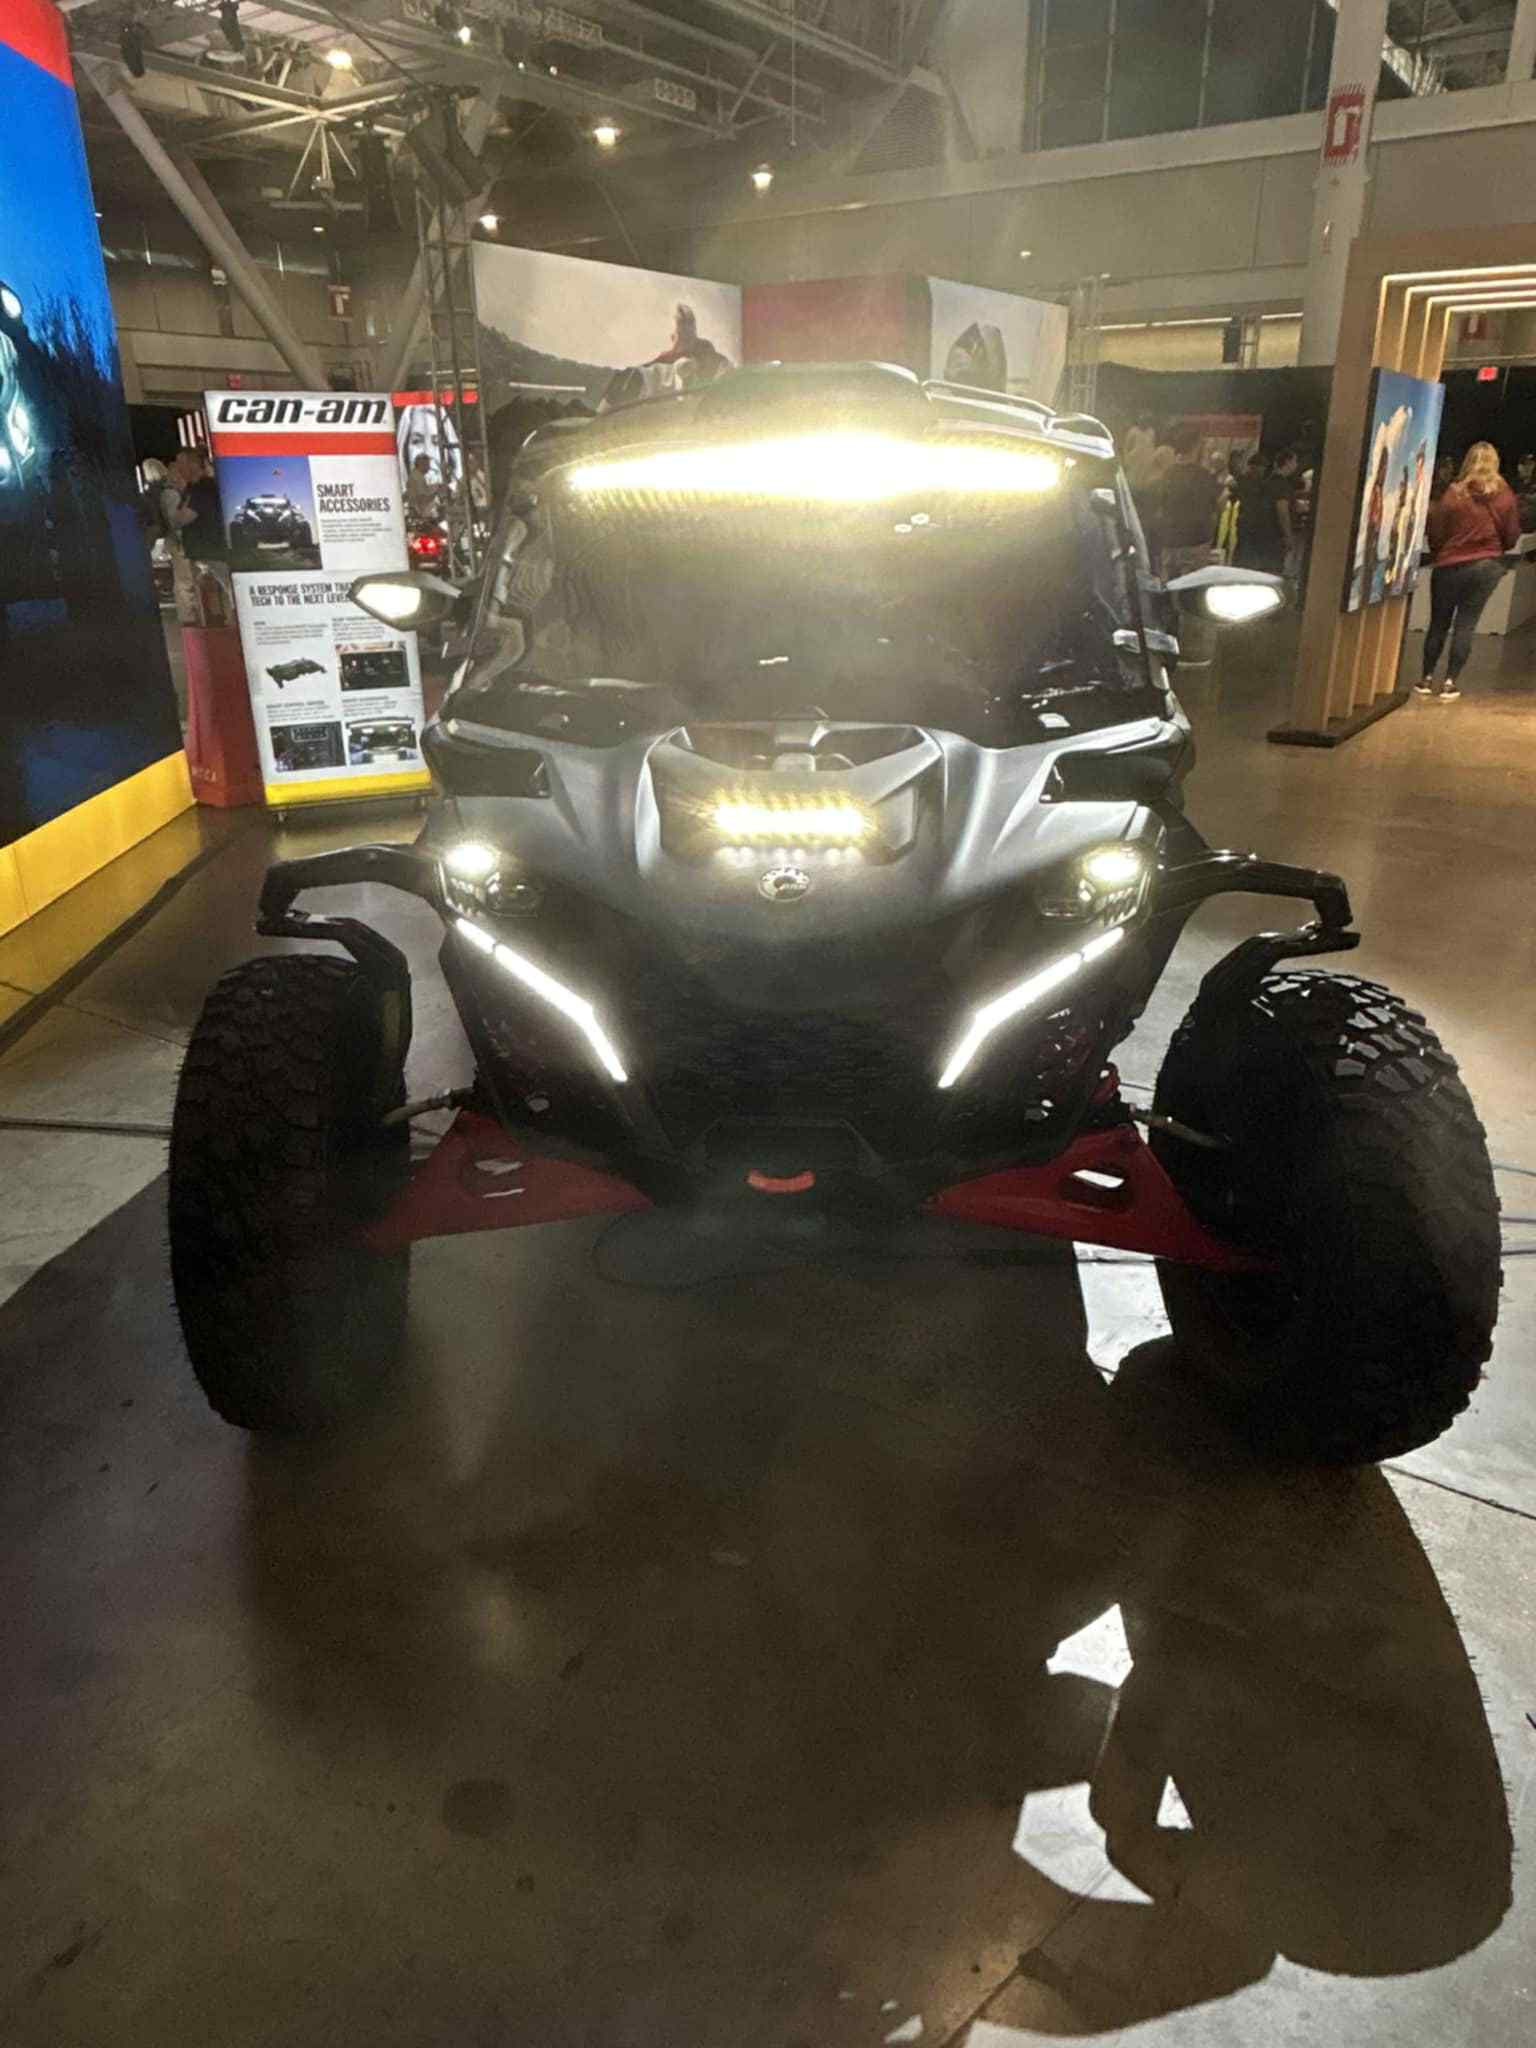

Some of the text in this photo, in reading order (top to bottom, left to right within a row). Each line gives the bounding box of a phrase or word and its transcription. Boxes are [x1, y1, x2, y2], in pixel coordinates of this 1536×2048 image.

[317, 484, 354, 498] SMART
[319, 499, 391, 513] ACCESSORIES
[249, 585, 256, 596] A
[257, 583, 299, 595] RESPONSE
[301, 582, 332, 594] SYSTEM
[251, 596, 272, 607] TECH
[274, 595, 285, 606] TO
[287, 595, 301, 606] THE
[303, 594, 325, 605] NEXT
